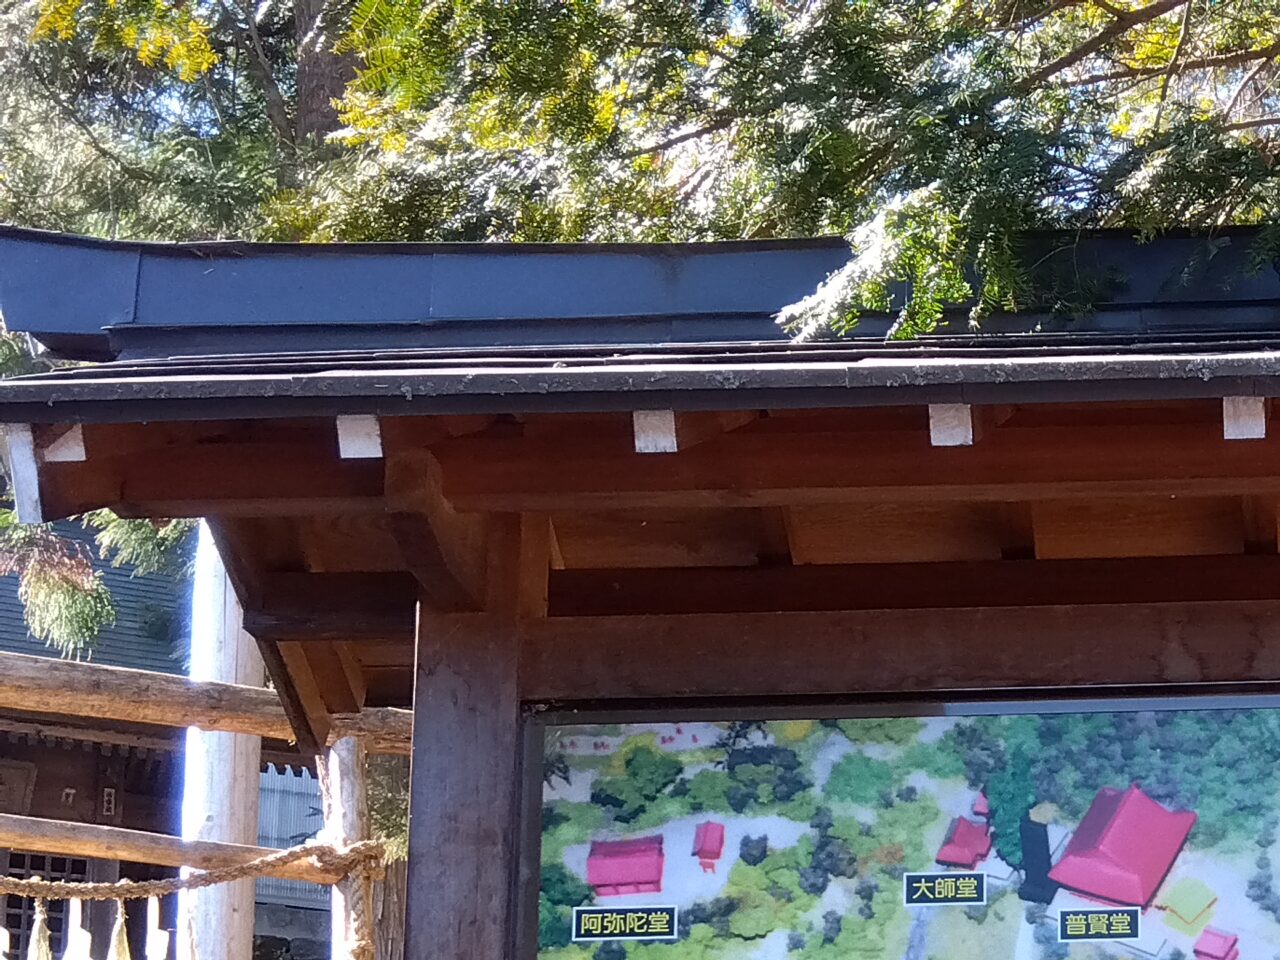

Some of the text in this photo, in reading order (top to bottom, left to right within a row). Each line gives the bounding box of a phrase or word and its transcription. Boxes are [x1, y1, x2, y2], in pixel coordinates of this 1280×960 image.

[912, 878, 979, 900] 大師堂
[580, 912, 671, 935] 阿弥陀堂
[1065, 913, 1132, 936] 普賢堂
